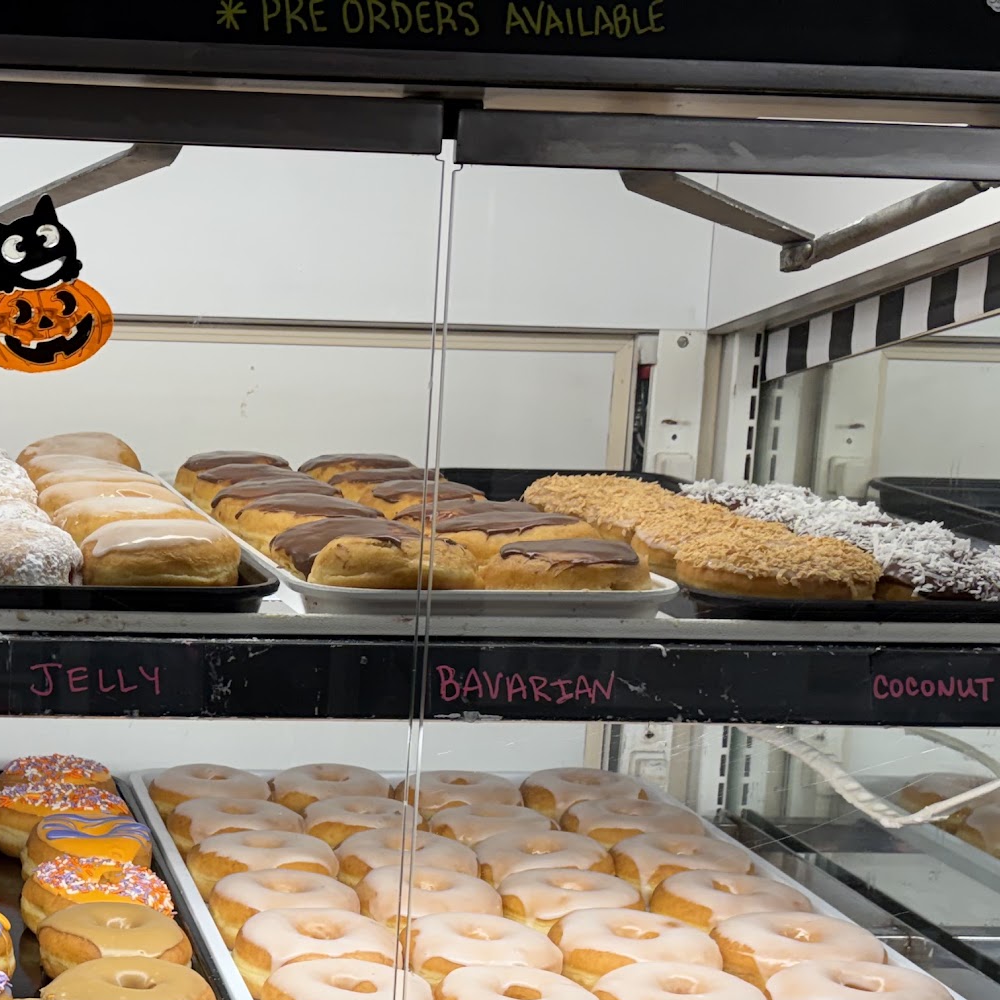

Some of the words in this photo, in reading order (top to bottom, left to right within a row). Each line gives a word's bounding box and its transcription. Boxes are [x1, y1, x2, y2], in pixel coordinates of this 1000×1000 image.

[261, 0, 328, 34] PRE
[341, 0, 480, 36] ORDERS
[504, 0, 667, 39] AVAILABLE
[29, 662, 166, 697] JELLY
[436, 665, 617, 705] BAVARIAN
[872, 673, 994, 703] COCONUT
